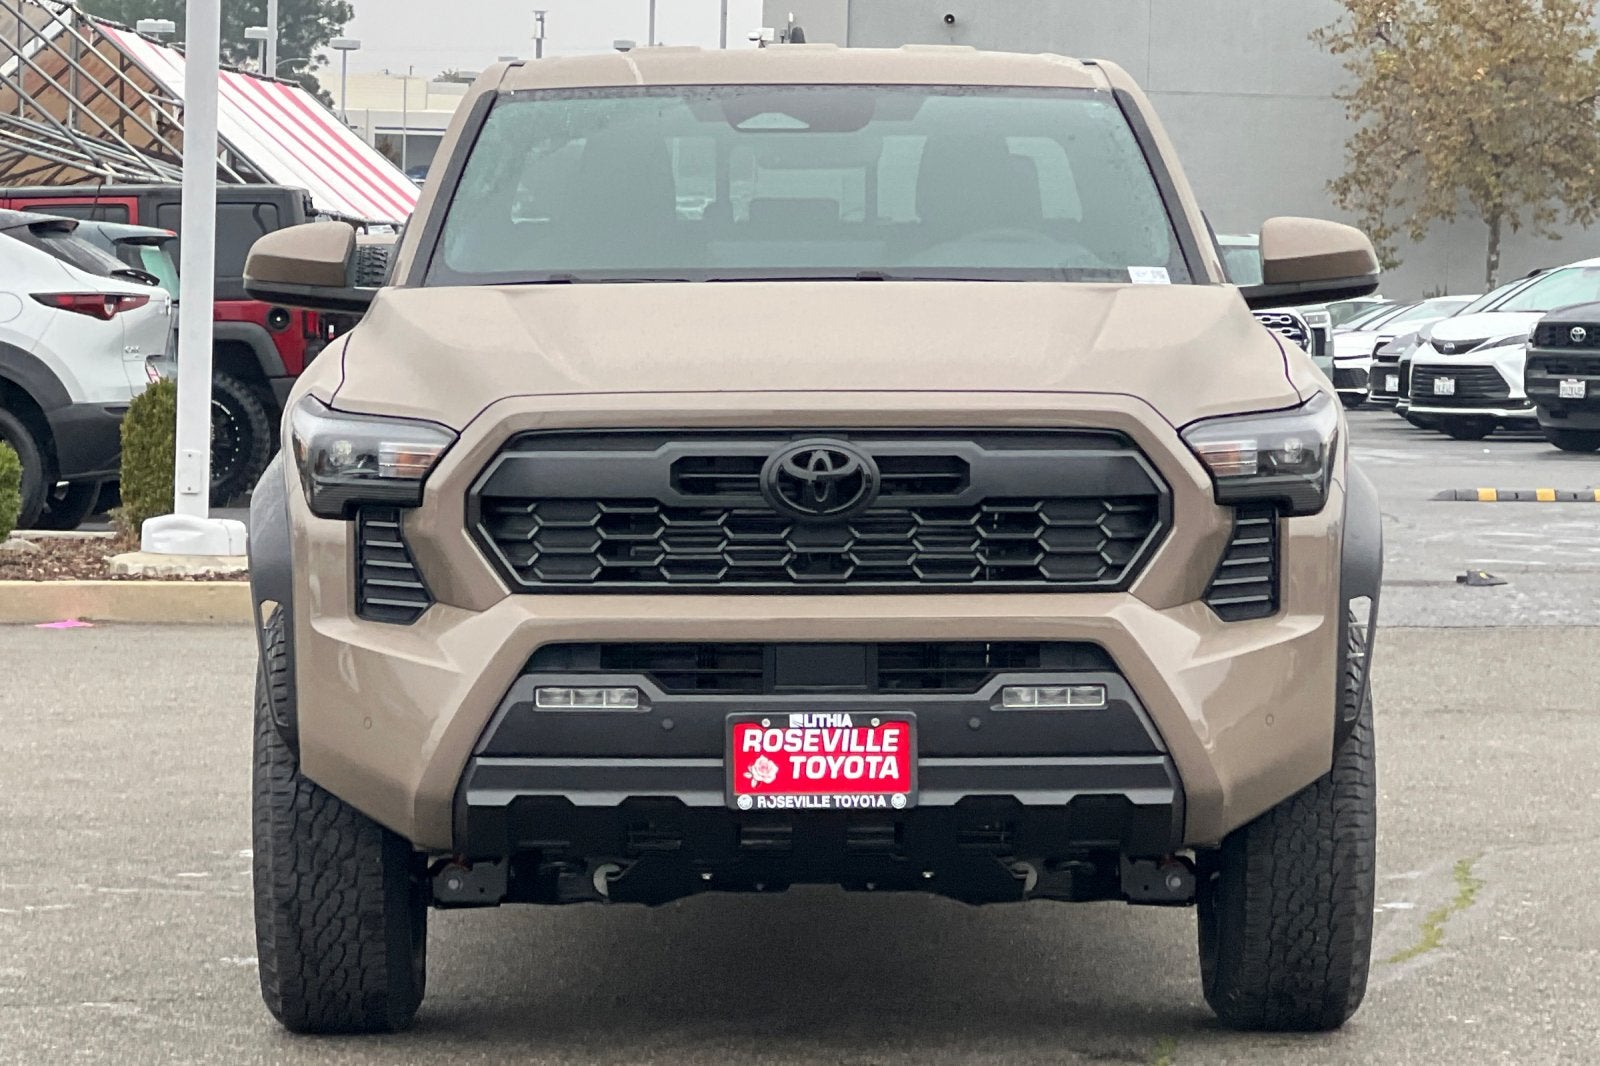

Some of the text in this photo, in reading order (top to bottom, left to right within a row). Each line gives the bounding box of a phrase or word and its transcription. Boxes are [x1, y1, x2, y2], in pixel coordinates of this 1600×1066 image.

[804, 714, 853, 728] LITHIA
[742, 729, 900, 753] ROSEVILLE
[789, 755, 900, 780] TOYOTA
[757, 795, 887, 808] ROSEVILLE TOYOTA
